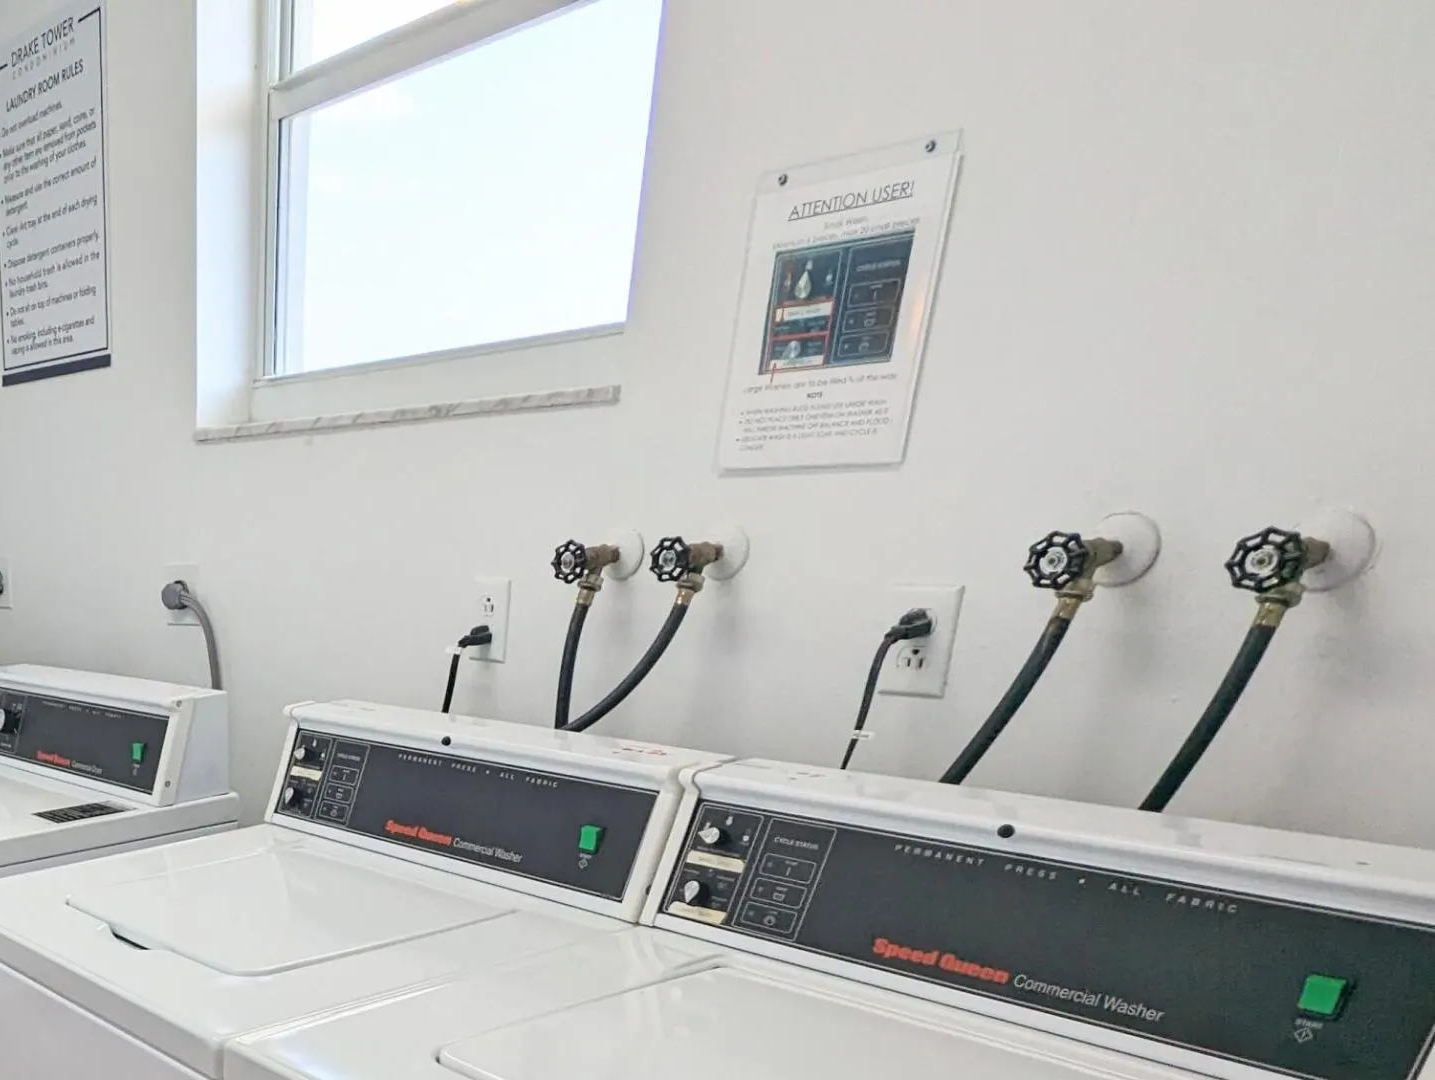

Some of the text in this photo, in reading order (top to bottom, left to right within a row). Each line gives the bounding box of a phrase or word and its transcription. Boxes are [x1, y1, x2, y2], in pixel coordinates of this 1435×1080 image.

[11, 17, 73, 67] DRAKE TOWER
[6, 58, 84, 112] LAUNDRY ROOM RULES
[789, 180, 915, 219] ATTENTION USER!
[398, 753, 559, 789] PERMANENT PRESS ALL FABRIC
[453, 837, 494, 856] Commercial
[494, 847, 523, 863] Washer
[894, 844, 1239, 914] PERMANENT PRESS ALL FABRIC
[872, 937, 1166, 1023] Speed Queen Commercial Washer
